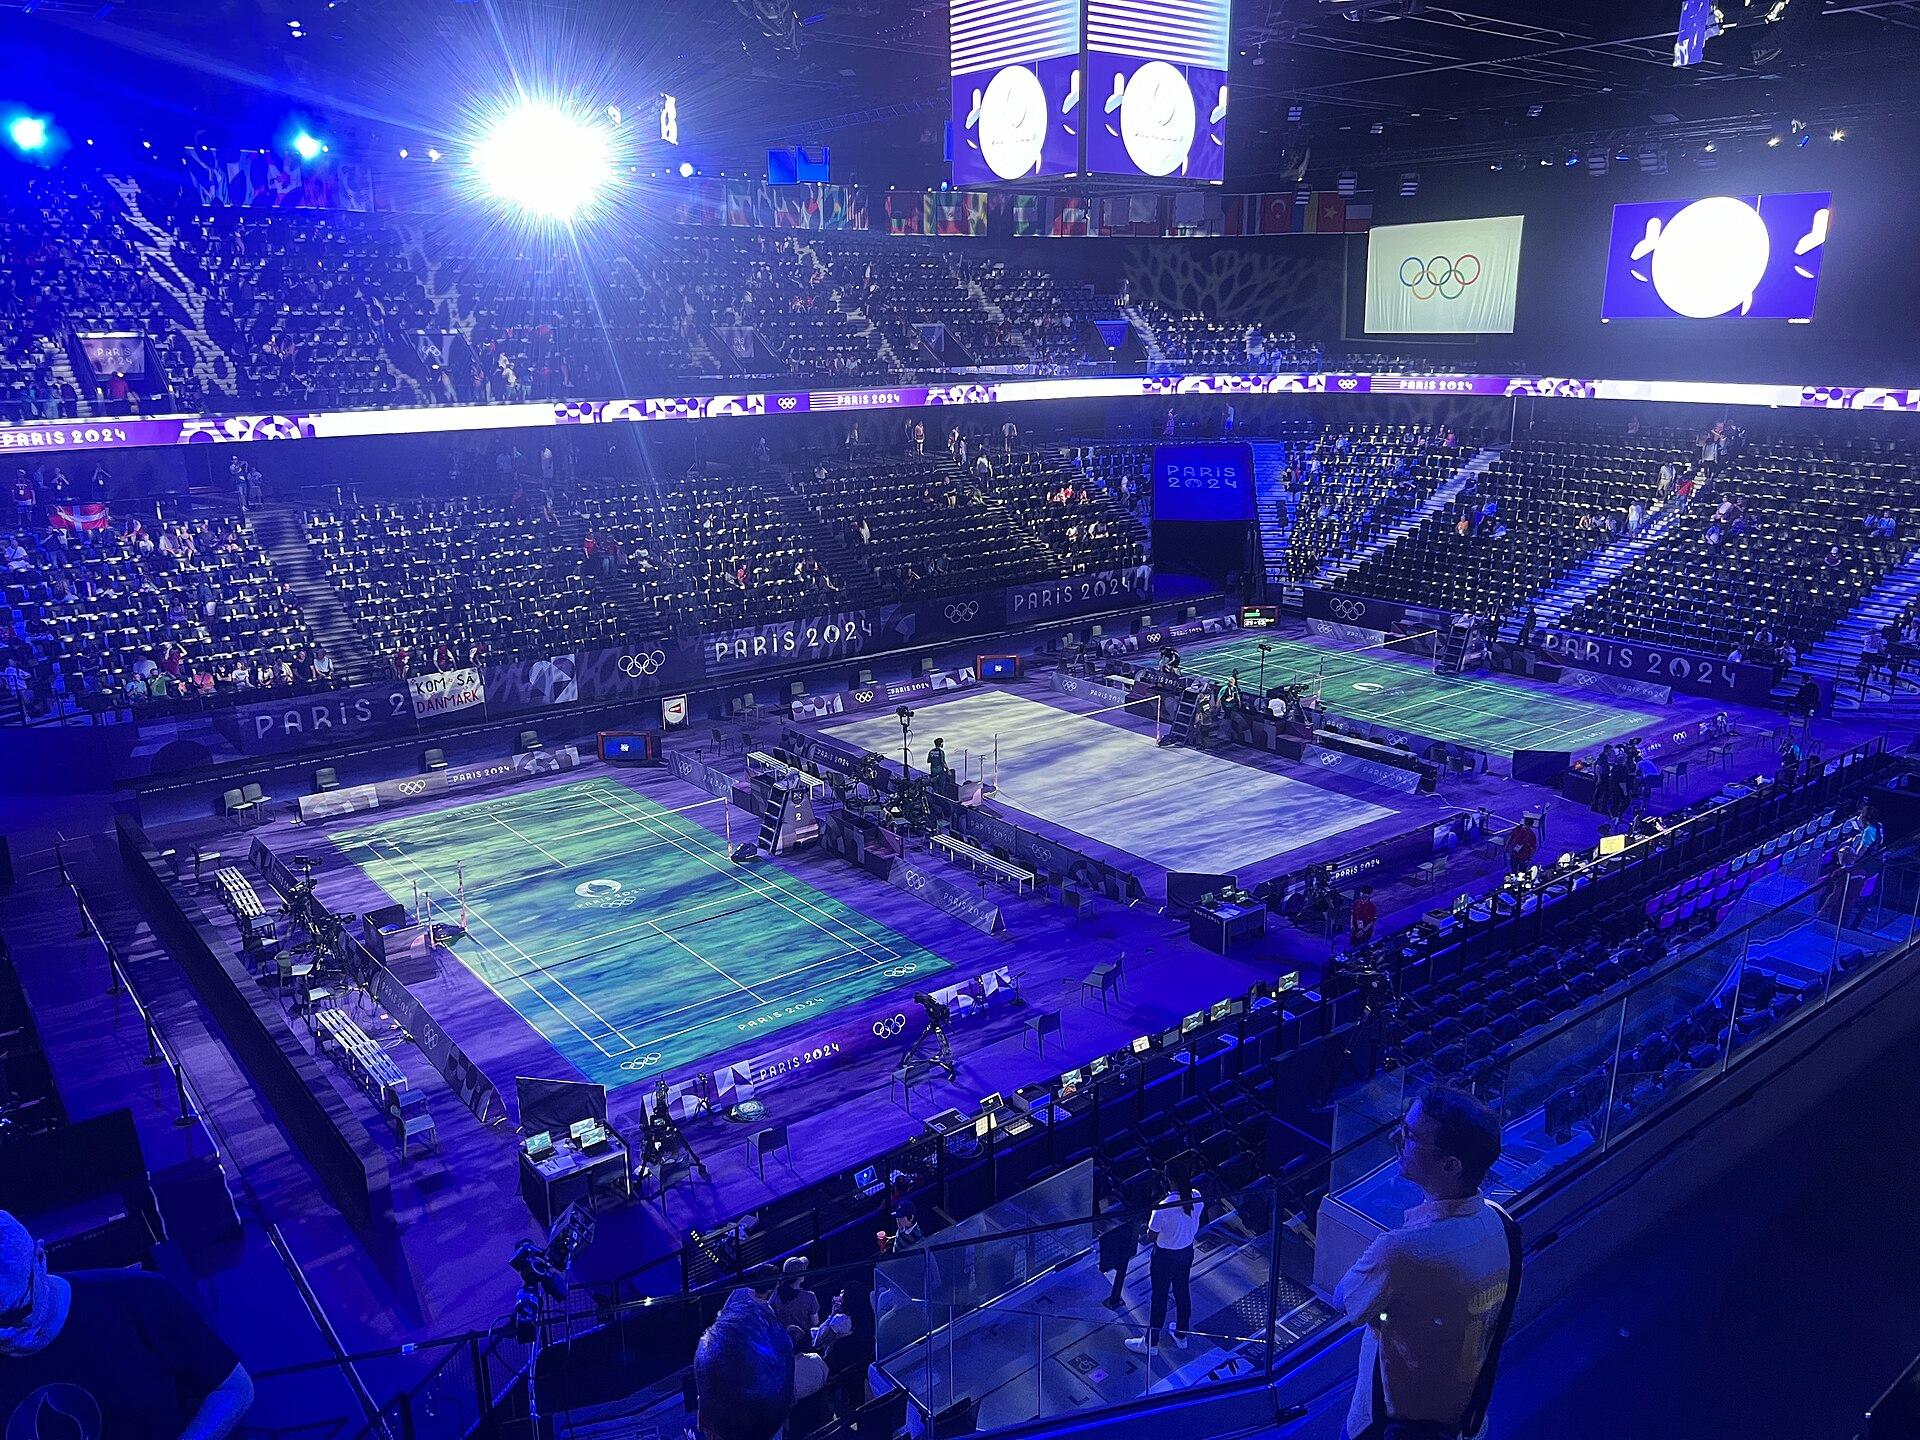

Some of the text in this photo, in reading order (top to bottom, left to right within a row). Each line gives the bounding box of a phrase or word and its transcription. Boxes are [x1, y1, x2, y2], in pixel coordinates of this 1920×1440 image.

[1400, 380, 1473, 391] PARIS 2024
[838, 393, 900, 406] PARIS 2024
[0, 428, 126, 447] PARIS 2024
[1167, 465, 1236, 478] PARIS
[1167, 477, 1237, 489] 2024
[1014, 576, 1130, 612] PARIS 2024
[715, 619, 872, 662] PARIS 2024
[1545, 633, 1736, 688] PARIS 2024
[415, 677, 446, 695] KOM
[416, 688, 480, 714] DANMARK
[255, 698, 373, 739] PARIS
[453, 765, 511, 783] PARIS 2024
[1335, 858, 1380, 880] PARIS 2024
[738, 997, 825, 1032] PARIS 2024
[759, 1042, 841, 1081] PARIS 2024
